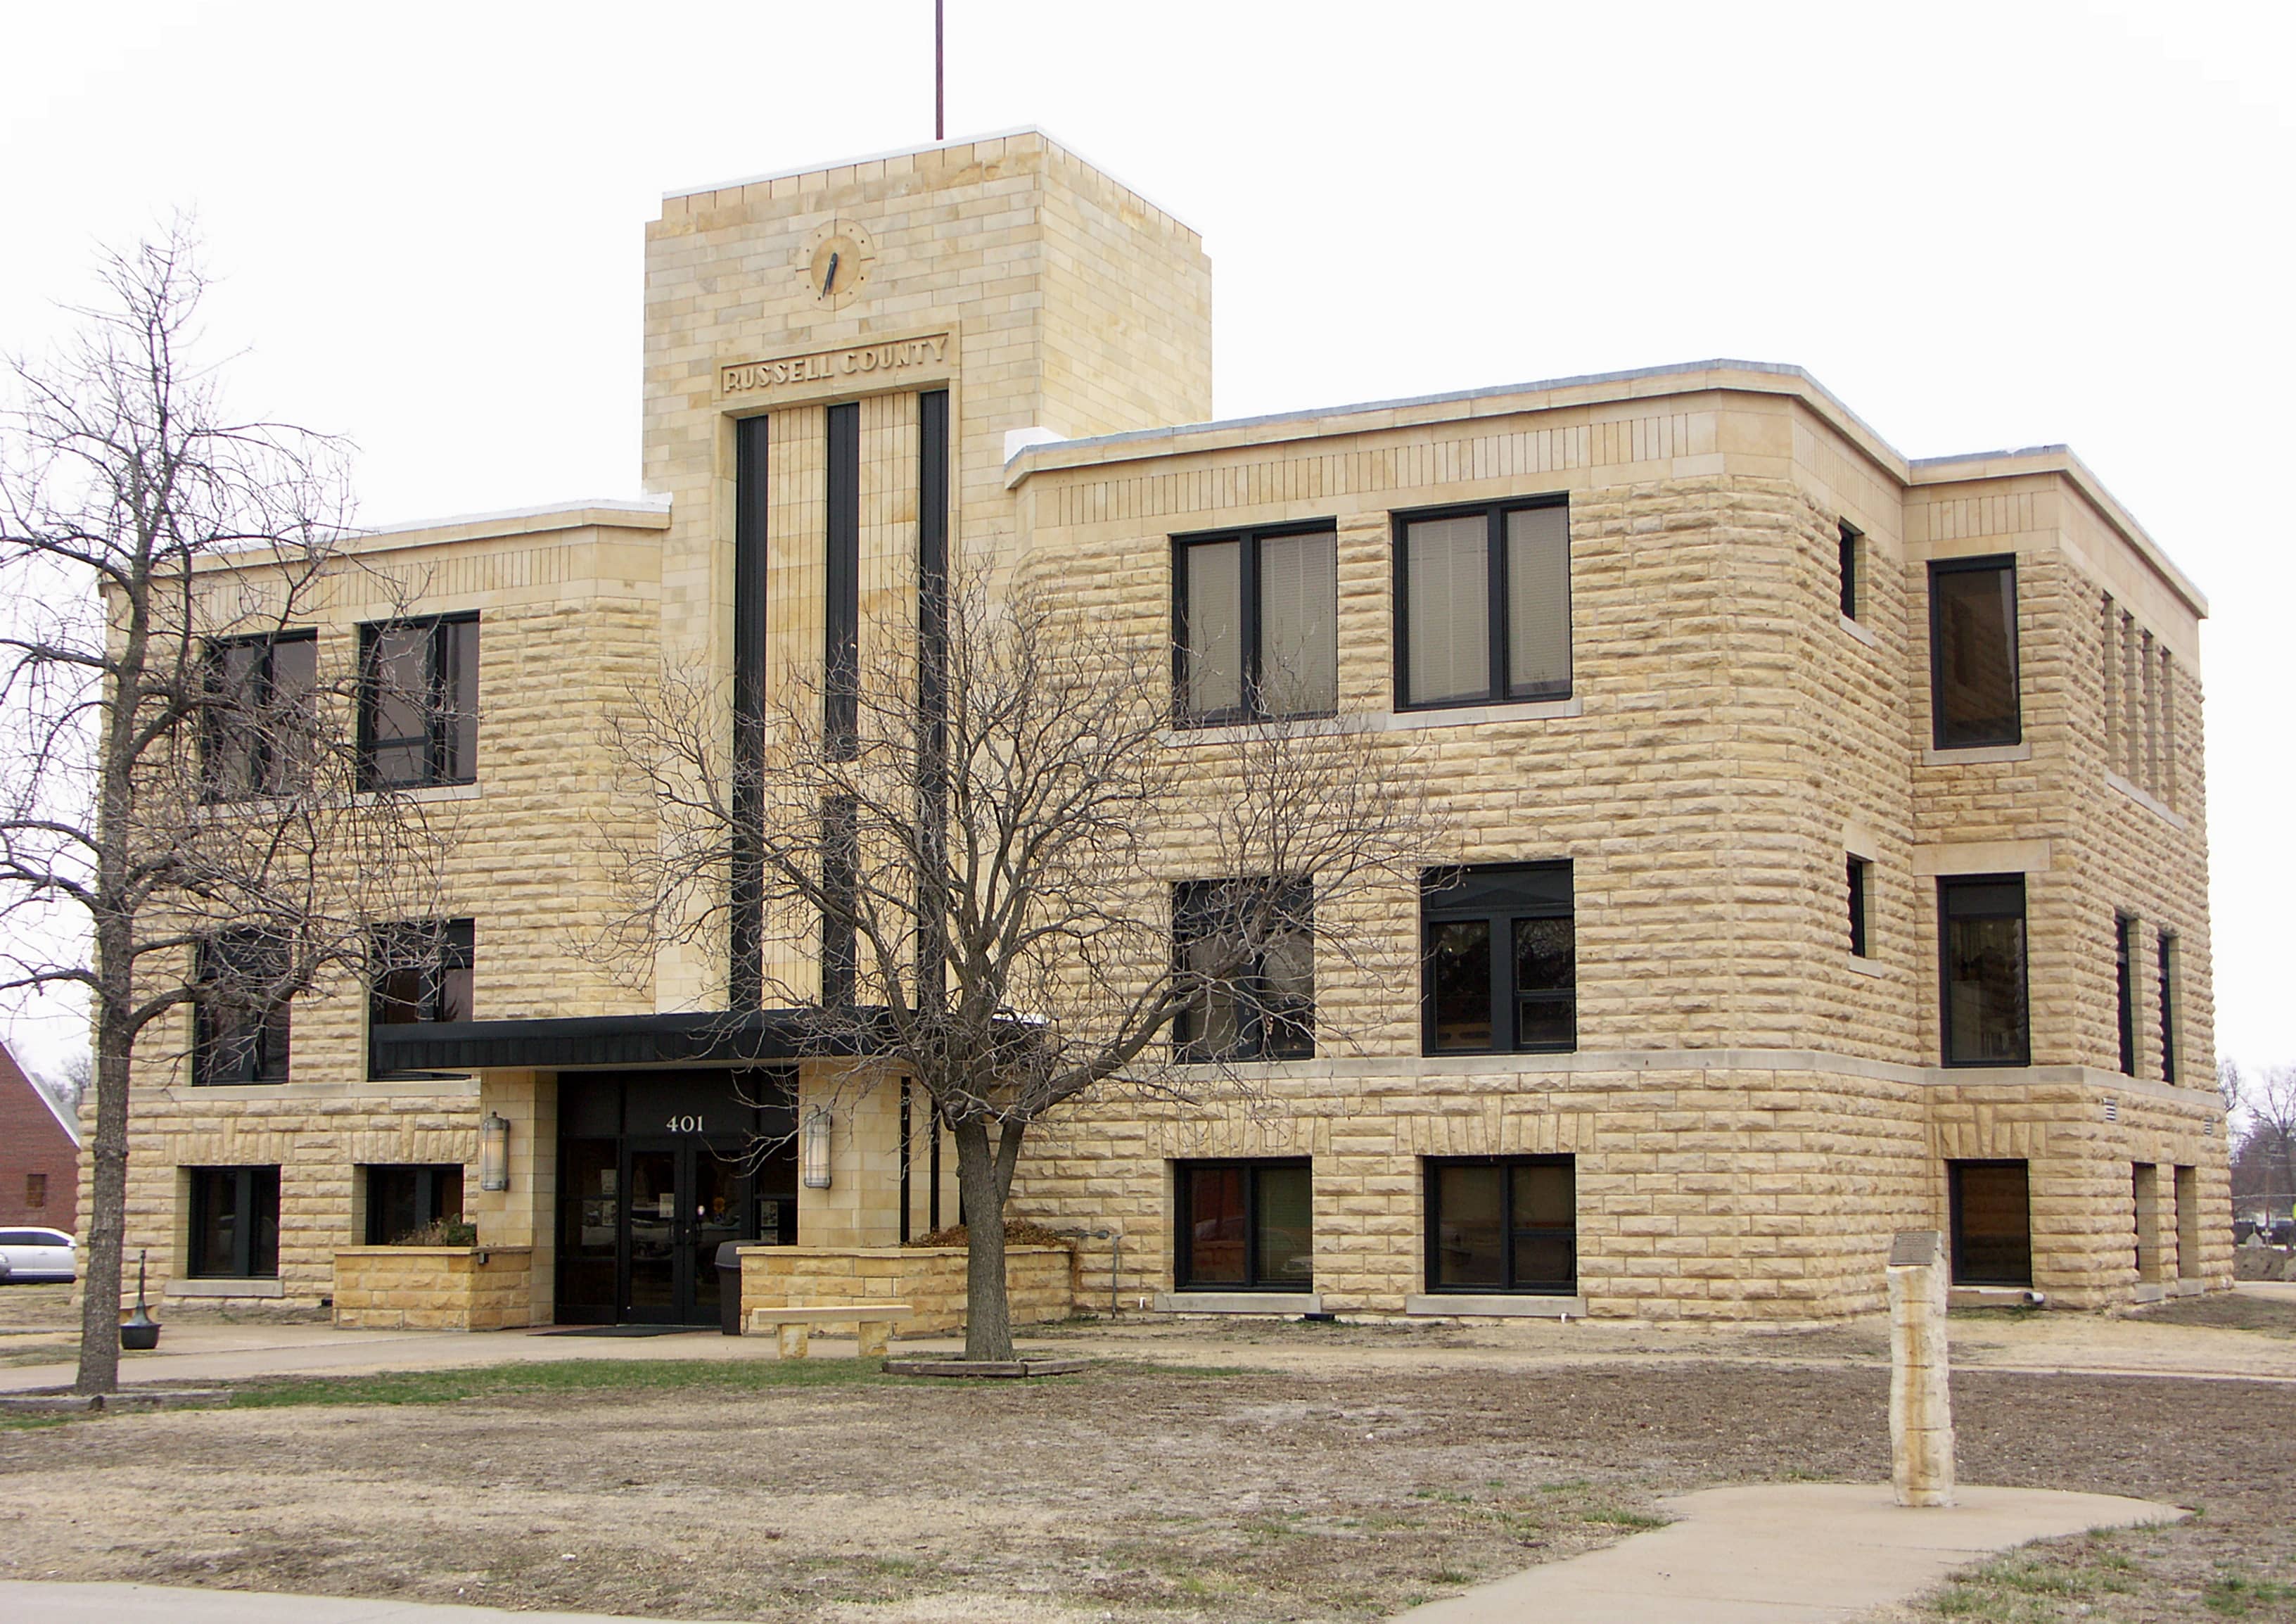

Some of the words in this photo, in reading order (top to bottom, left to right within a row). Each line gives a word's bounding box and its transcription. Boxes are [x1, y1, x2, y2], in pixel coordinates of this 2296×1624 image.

[723, 355, 834, 393] RUSSELL
[841, 337, 948, 374] COUNTY
[666, 1115, 703, 1132] 401
